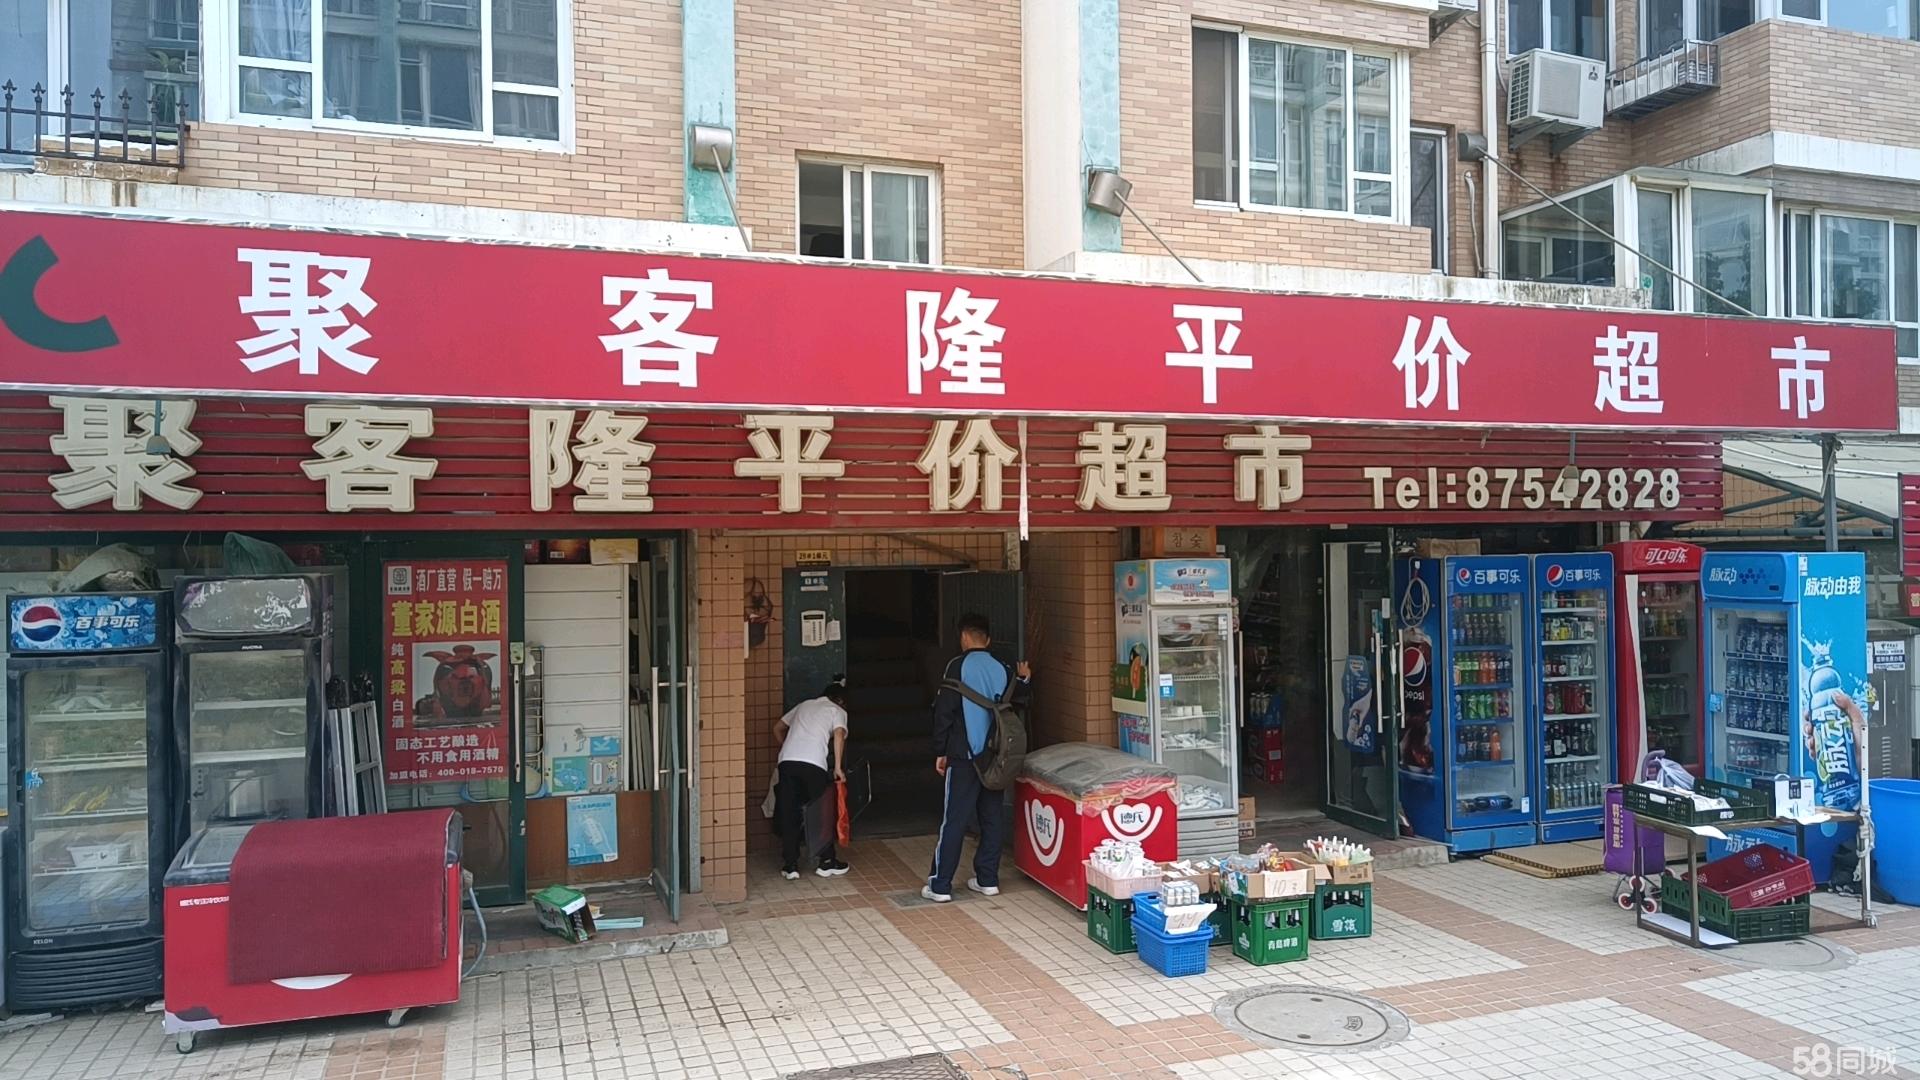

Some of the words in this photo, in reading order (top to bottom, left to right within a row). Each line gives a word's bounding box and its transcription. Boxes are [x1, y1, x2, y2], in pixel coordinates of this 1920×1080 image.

[235, 246, 1833, 420] 聚客隆平价超市
[47, 394, 1312, 515] 聚客隆平价超市
[1363, 466, 1681, 510] Tel:87542828
[1644, 547, 1690, 566] 可口可乐
[416, 568, 457, 592] 酒厂直营
[463, 567, 502, 591] 假一赔万
[1474, 569, 1522, 585] 百事可乐
[1564, 568, 1601, 583] 百事可乐
[1709, 567, 1738, 585] 脉动
[1804, 575, 1861, 600] 脉动由我
[75, 614, 141, 633] 百事可乐
[391, 598, 501, 637] 董家源白酒
[395, 734, 480, 751] 固态工艺酿造
[416, 747, 500, 764] 不用食用酒精
[436, 766, 504, 776] 400-018-7570
[1331, 917, 1357, 934] 雪花
[1267, 937, 1298, 950] 青岛啤酒
